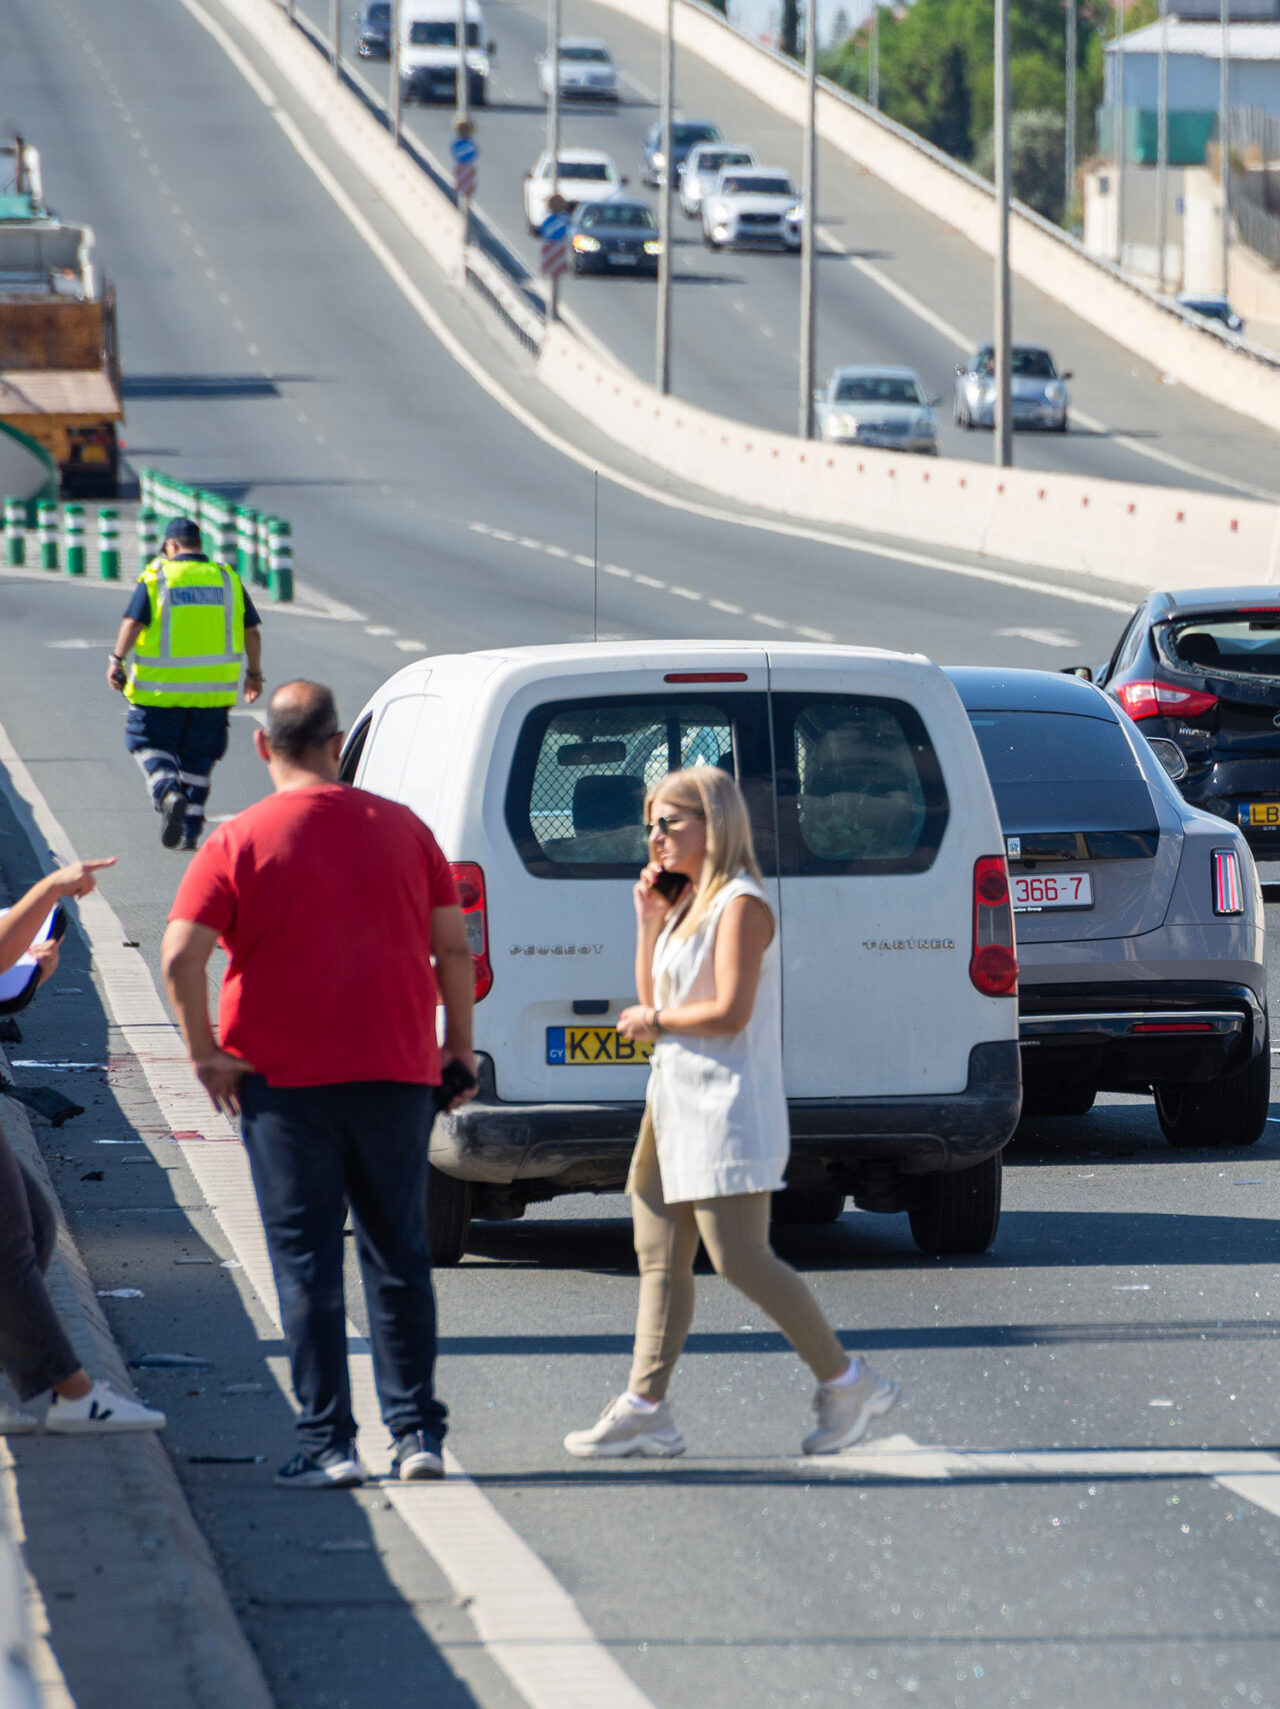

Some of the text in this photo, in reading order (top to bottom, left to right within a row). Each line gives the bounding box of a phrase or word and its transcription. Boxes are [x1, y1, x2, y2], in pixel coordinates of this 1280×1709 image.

[1015, 876, 1083, 902] 366-7
[509, 944, 604, 956] PEUGEOT
[862, 938, 955, 951] PARTNER
[569, 1031, 636, 1060] KXB
[549, 1048, 564, 1058] CY
